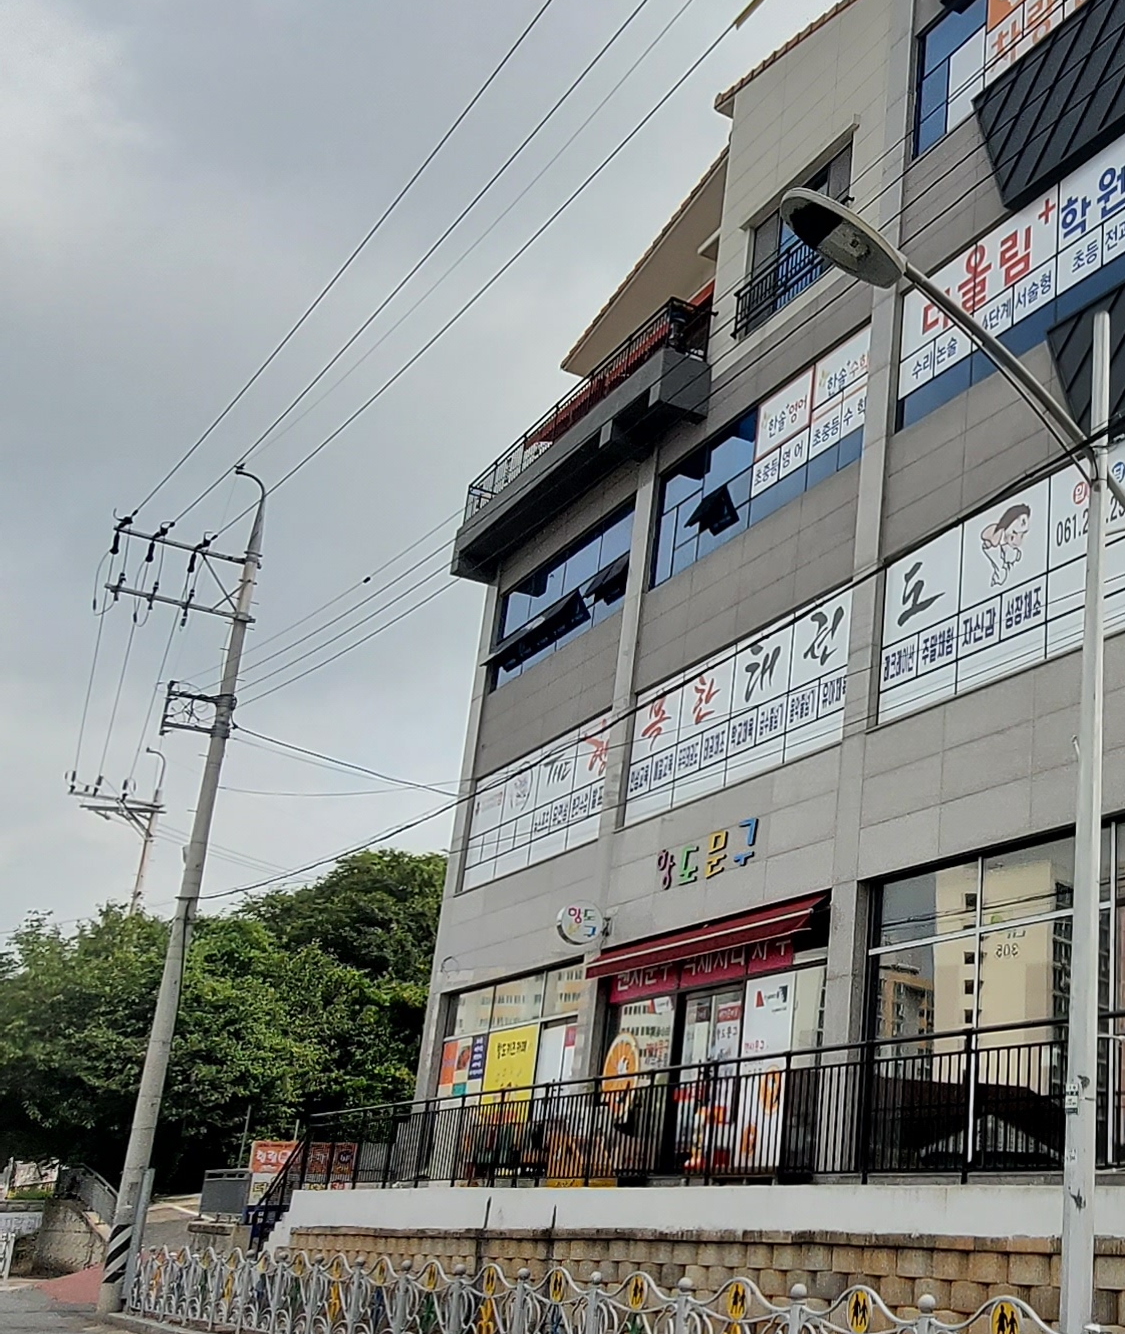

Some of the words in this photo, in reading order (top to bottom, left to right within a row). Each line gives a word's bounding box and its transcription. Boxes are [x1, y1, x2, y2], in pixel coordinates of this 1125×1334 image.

[1015, 269, 1052, 310] 서술형
[1071, 244, 1099, 274] 초등
[962, 607, 997, 647] 자신감
[657, 817, 758, 890] 항도문구
